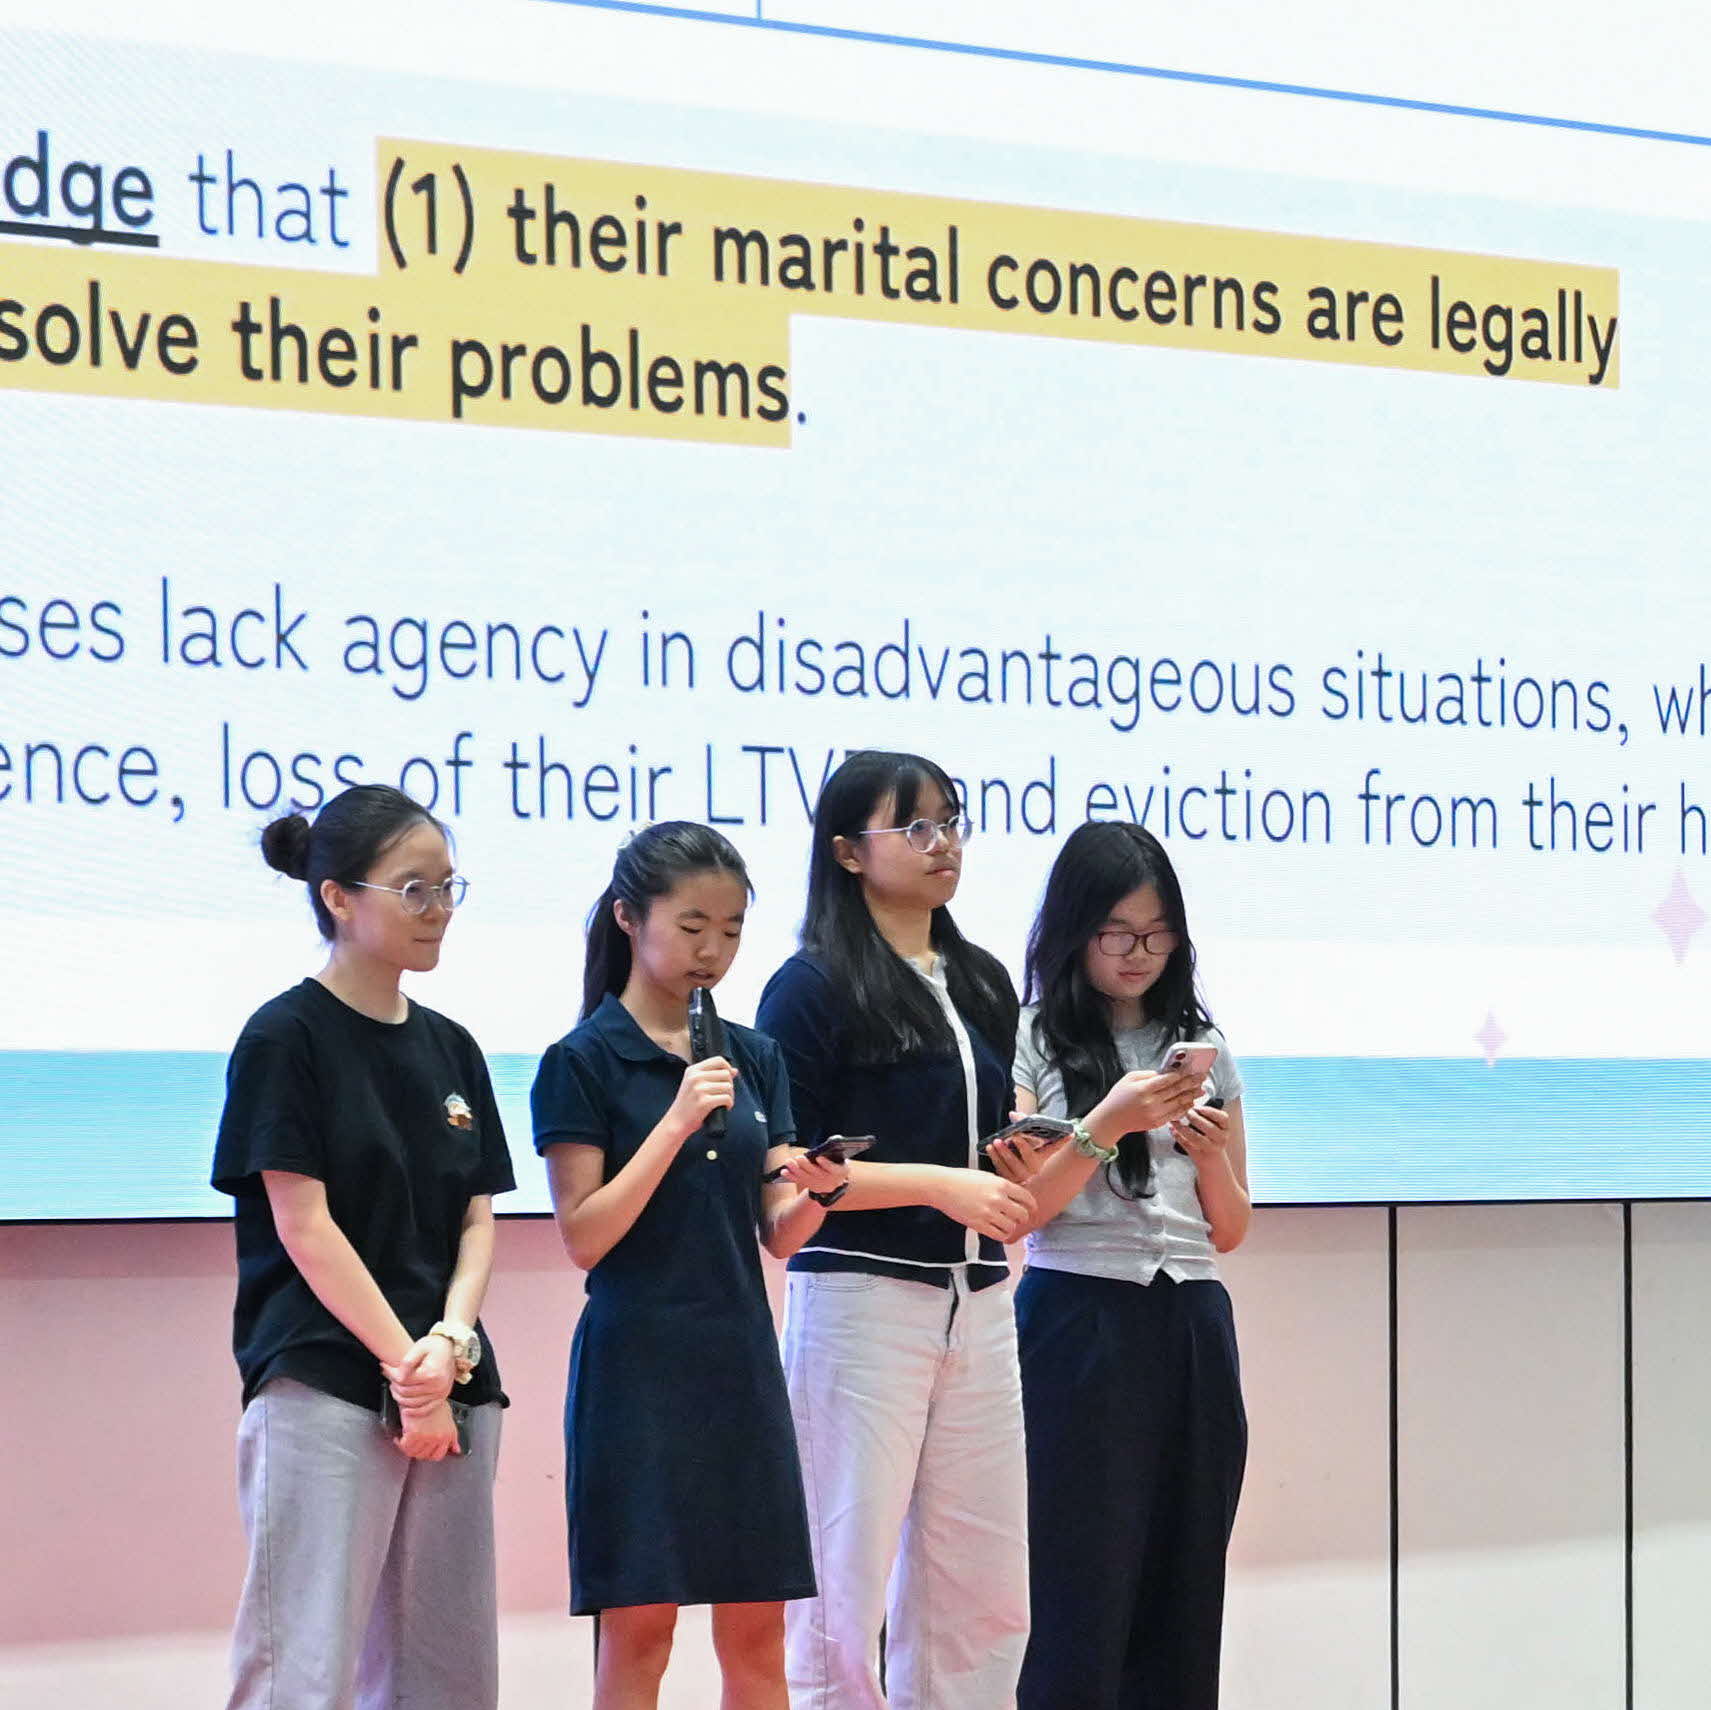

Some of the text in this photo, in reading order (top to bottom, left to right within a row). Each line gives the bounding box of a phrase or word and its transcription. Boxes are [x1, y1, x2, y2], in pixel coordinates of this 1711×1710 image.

[189, 150, 350, 248] that
[385, 158, 475, 273] (1)
[507, 184, 683, 276] their
[714, 218, 959, 304] marital
[988, 255, 1281, 336] concerns
[1308, 287, 1404, 346] are
[1431, 276, 1618, 385] legally
[0, 281, 806, 425] solve their problems.
[0, 595, 125, 662] ses
[161, 577, 309, 671] lack
[344, 614, 608, 708] agency
[641, 610, 695, 689] in
[727, 611, 1295, 732] disadvantageous
[1322, 650, 1629, 745] situations,
[400, 732, 474, 816] of
[503, 736, 672, 822] their
[706, 743, 862, 826] LTV
[1086, 766, 1331, 843] eviction
[1357, 768, 1497, 849] from
[1522, 776, 1657, 852] their
